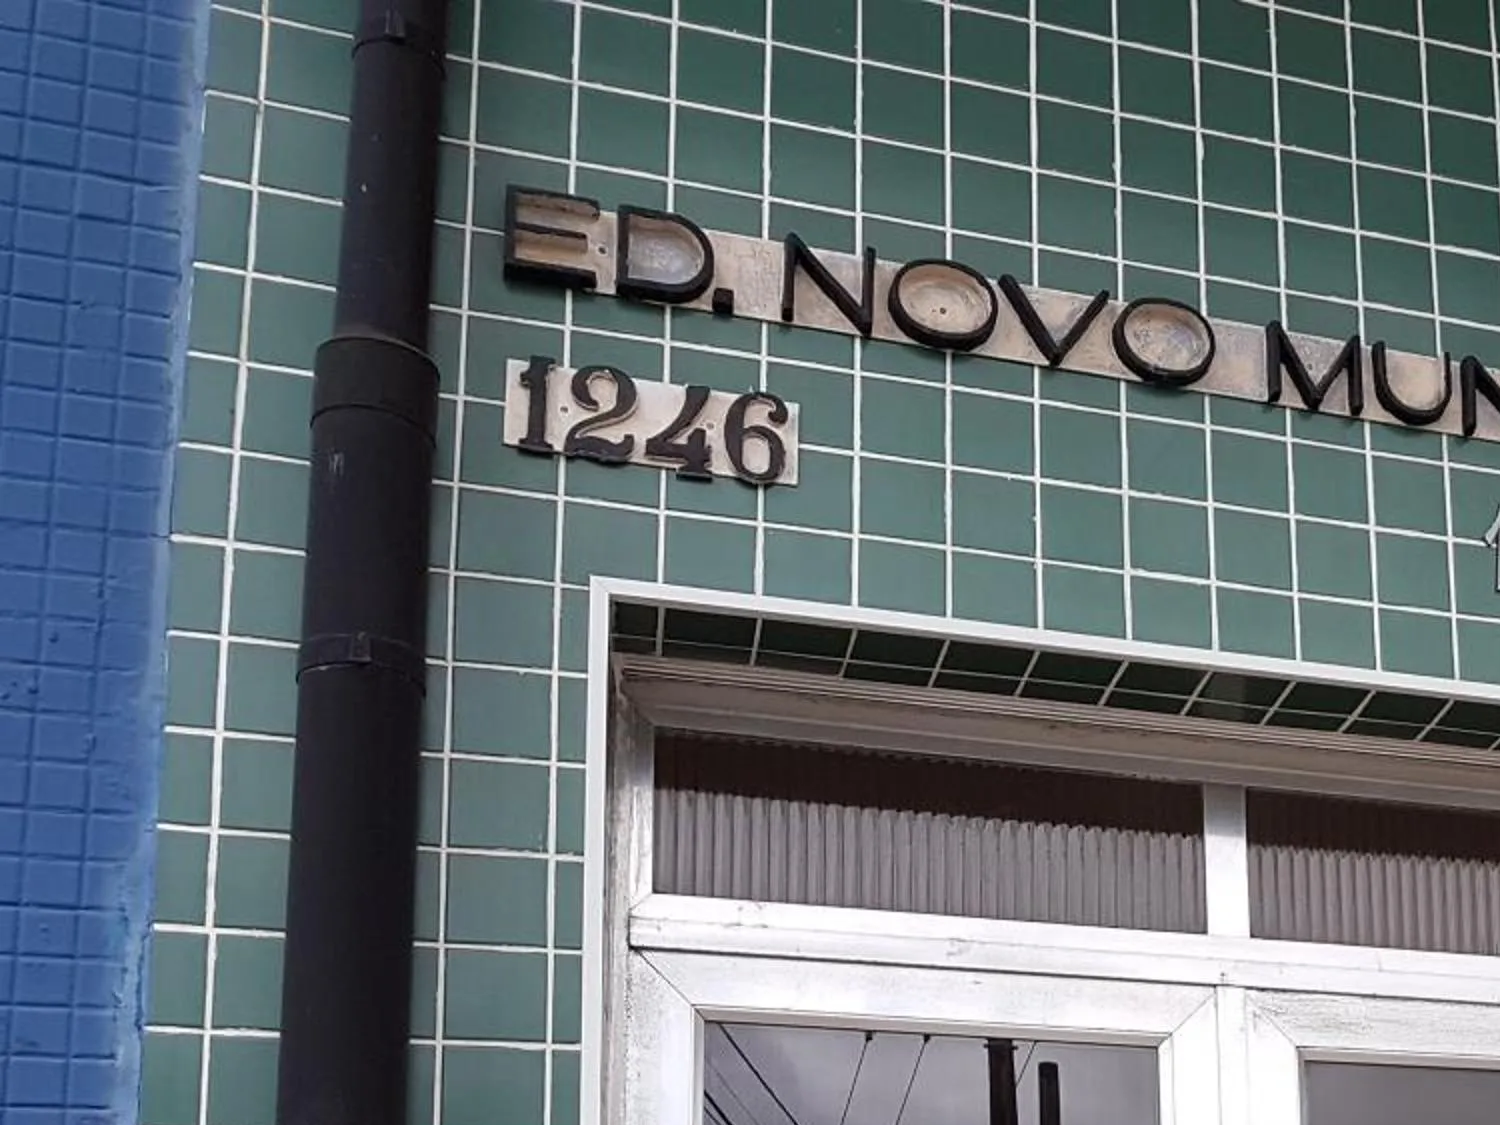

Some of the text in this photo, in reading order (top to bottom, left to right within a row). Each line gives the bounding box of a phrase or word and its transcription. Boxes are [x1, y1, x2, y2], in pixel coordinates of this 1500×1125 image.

[503, 184, 735, 316] ED.
[781, 231, 1216, 387] NOVO
[516, 355, 788, 486] 1246
